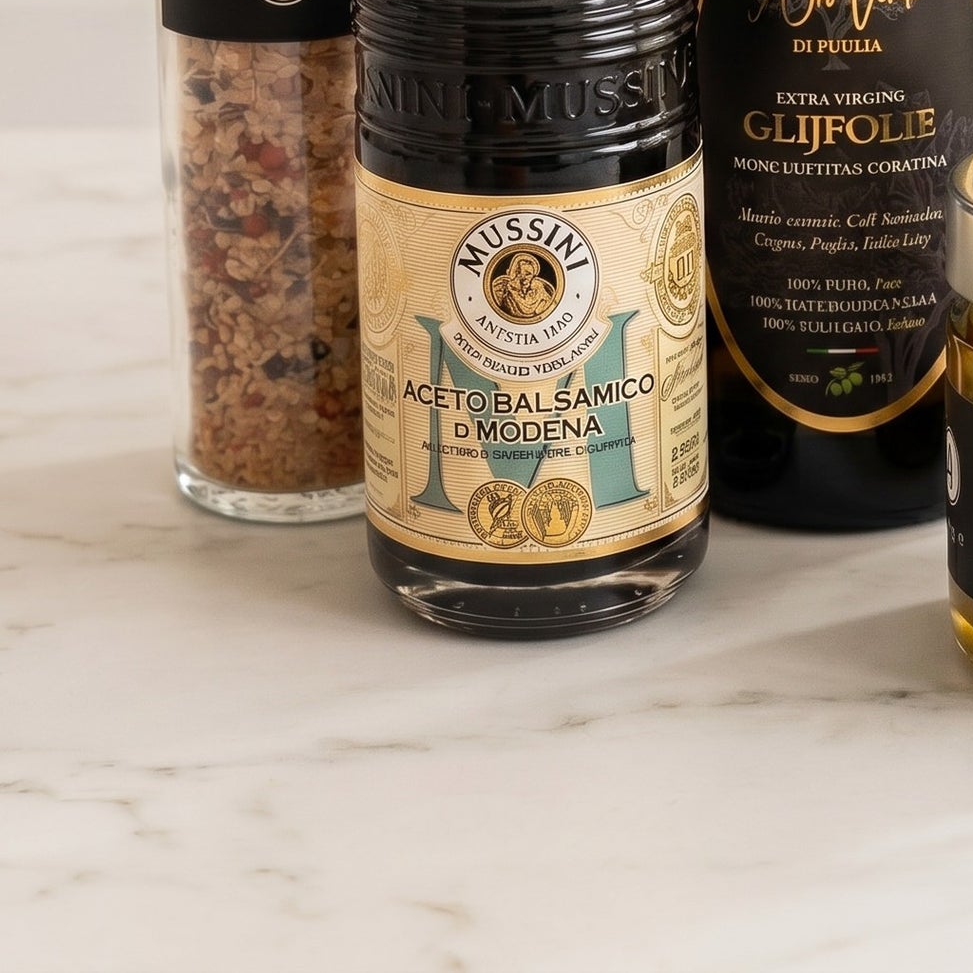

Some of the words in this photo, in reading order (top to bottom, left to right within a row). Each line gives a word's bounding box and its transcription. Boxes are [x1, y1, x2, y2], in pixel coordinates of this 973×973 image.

[792, 39, 812, 53] DI
[776, 92, 830, 106] EXTRA
[833, 89, 906, 106] VIRGING
[868, 154, 948, 175] CORATINA
[458, 218, 588, 276] MUSSINI
[403, 380, 486, 411] ACETO
[494, 374, 654, 414] BALSAMICO
[455, 422, 469, 438] D
[477, 416, 603, 443] MODENA
